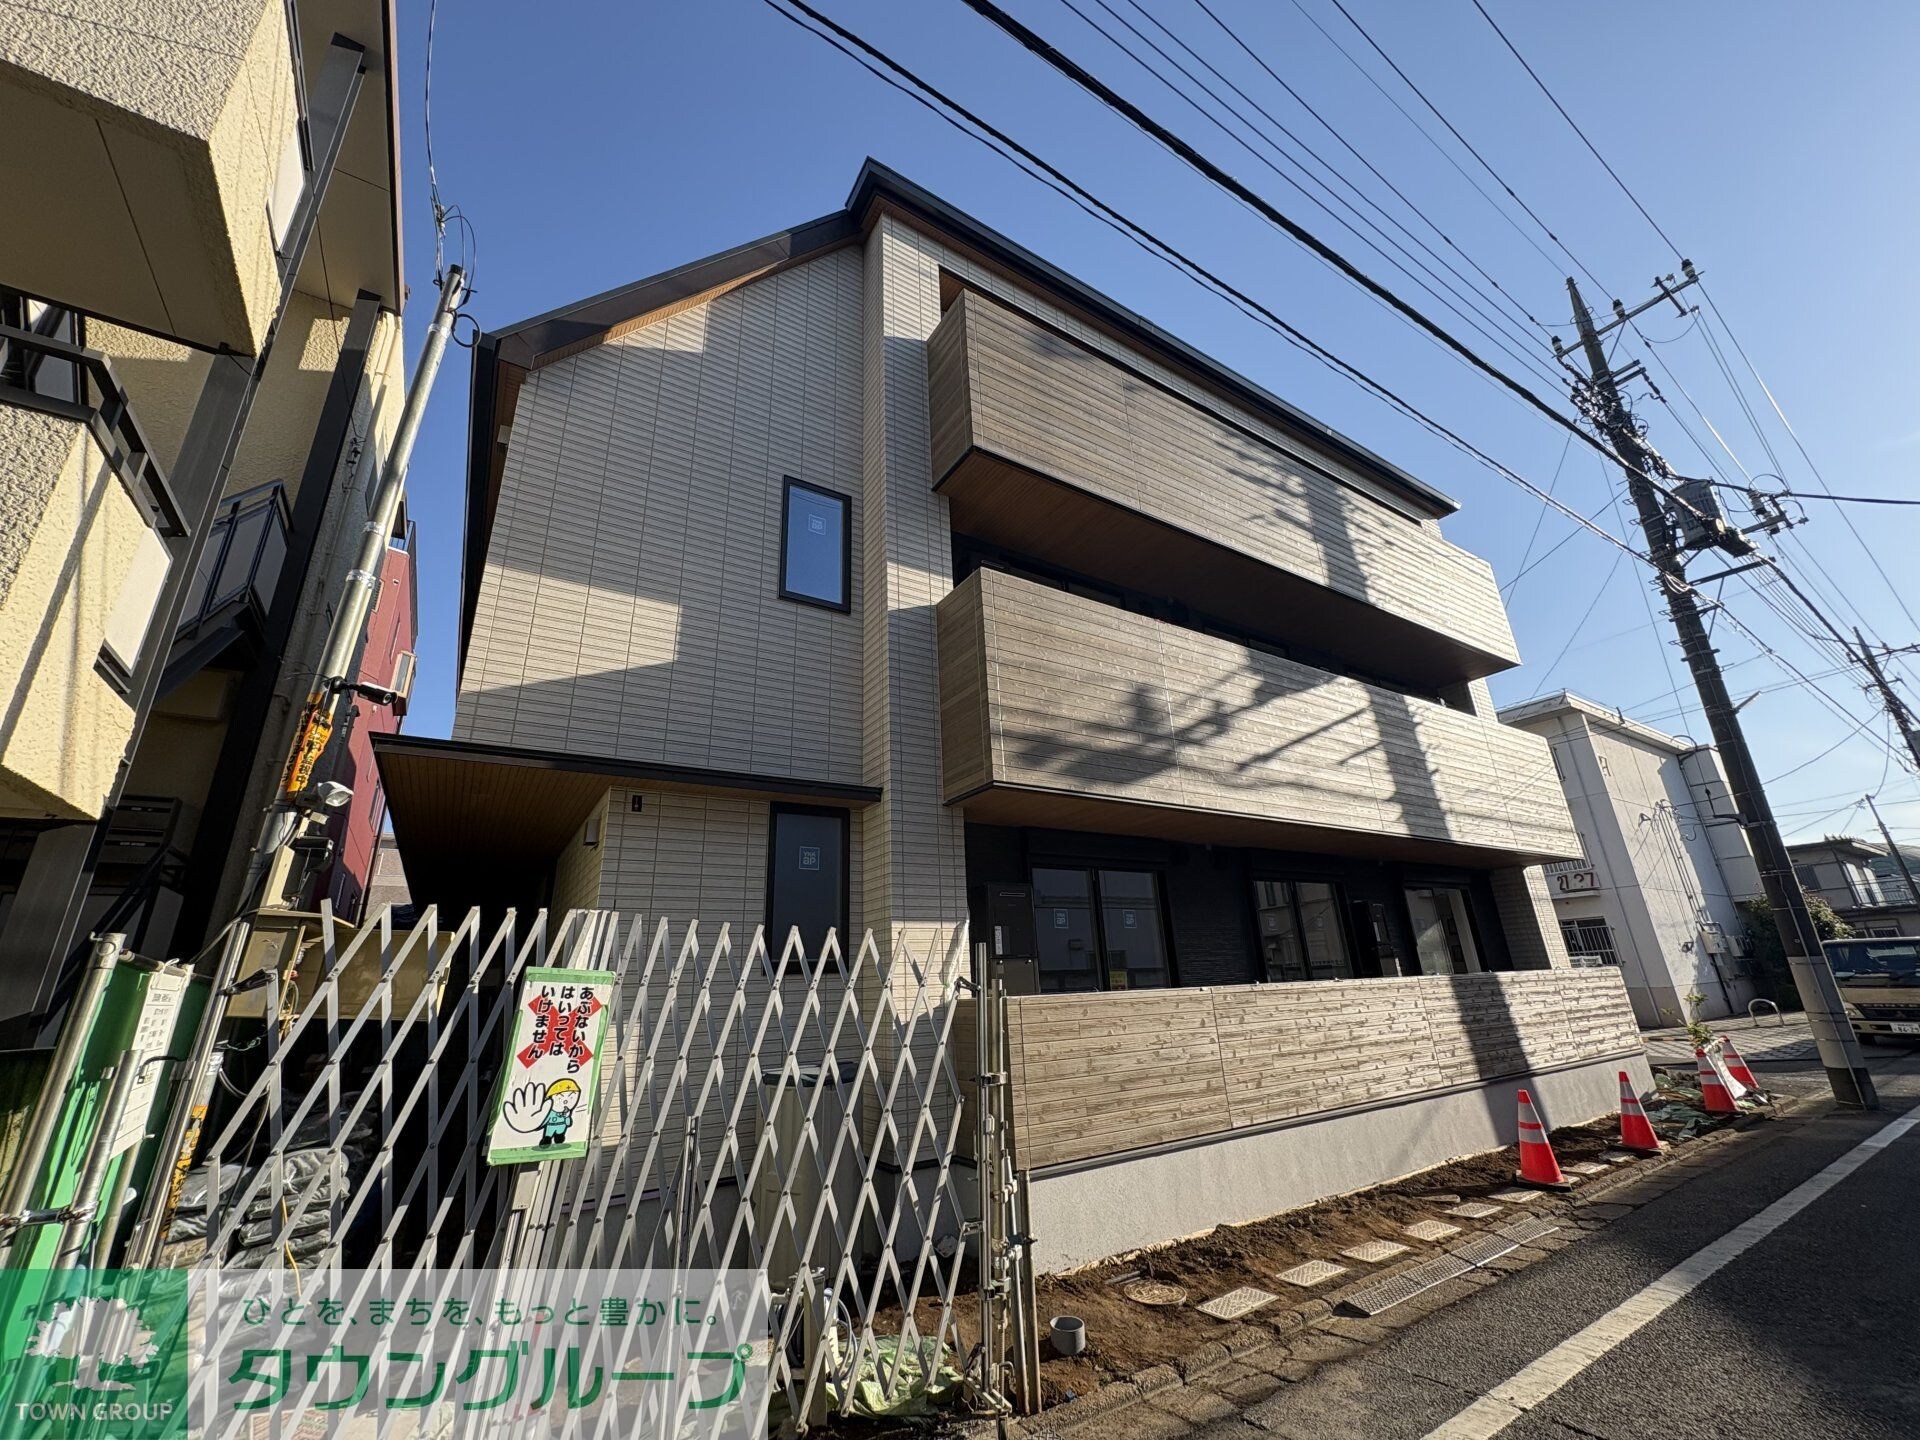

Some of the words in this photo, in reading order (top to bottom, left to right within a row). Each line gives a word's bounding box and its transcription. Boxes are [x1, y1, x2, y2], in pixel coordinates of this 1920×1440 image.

[528, 985, 556, 1059] いけません
[549, 985, 576, 1057] はいっては
[567, 986, 595, 1074] あぶないから
